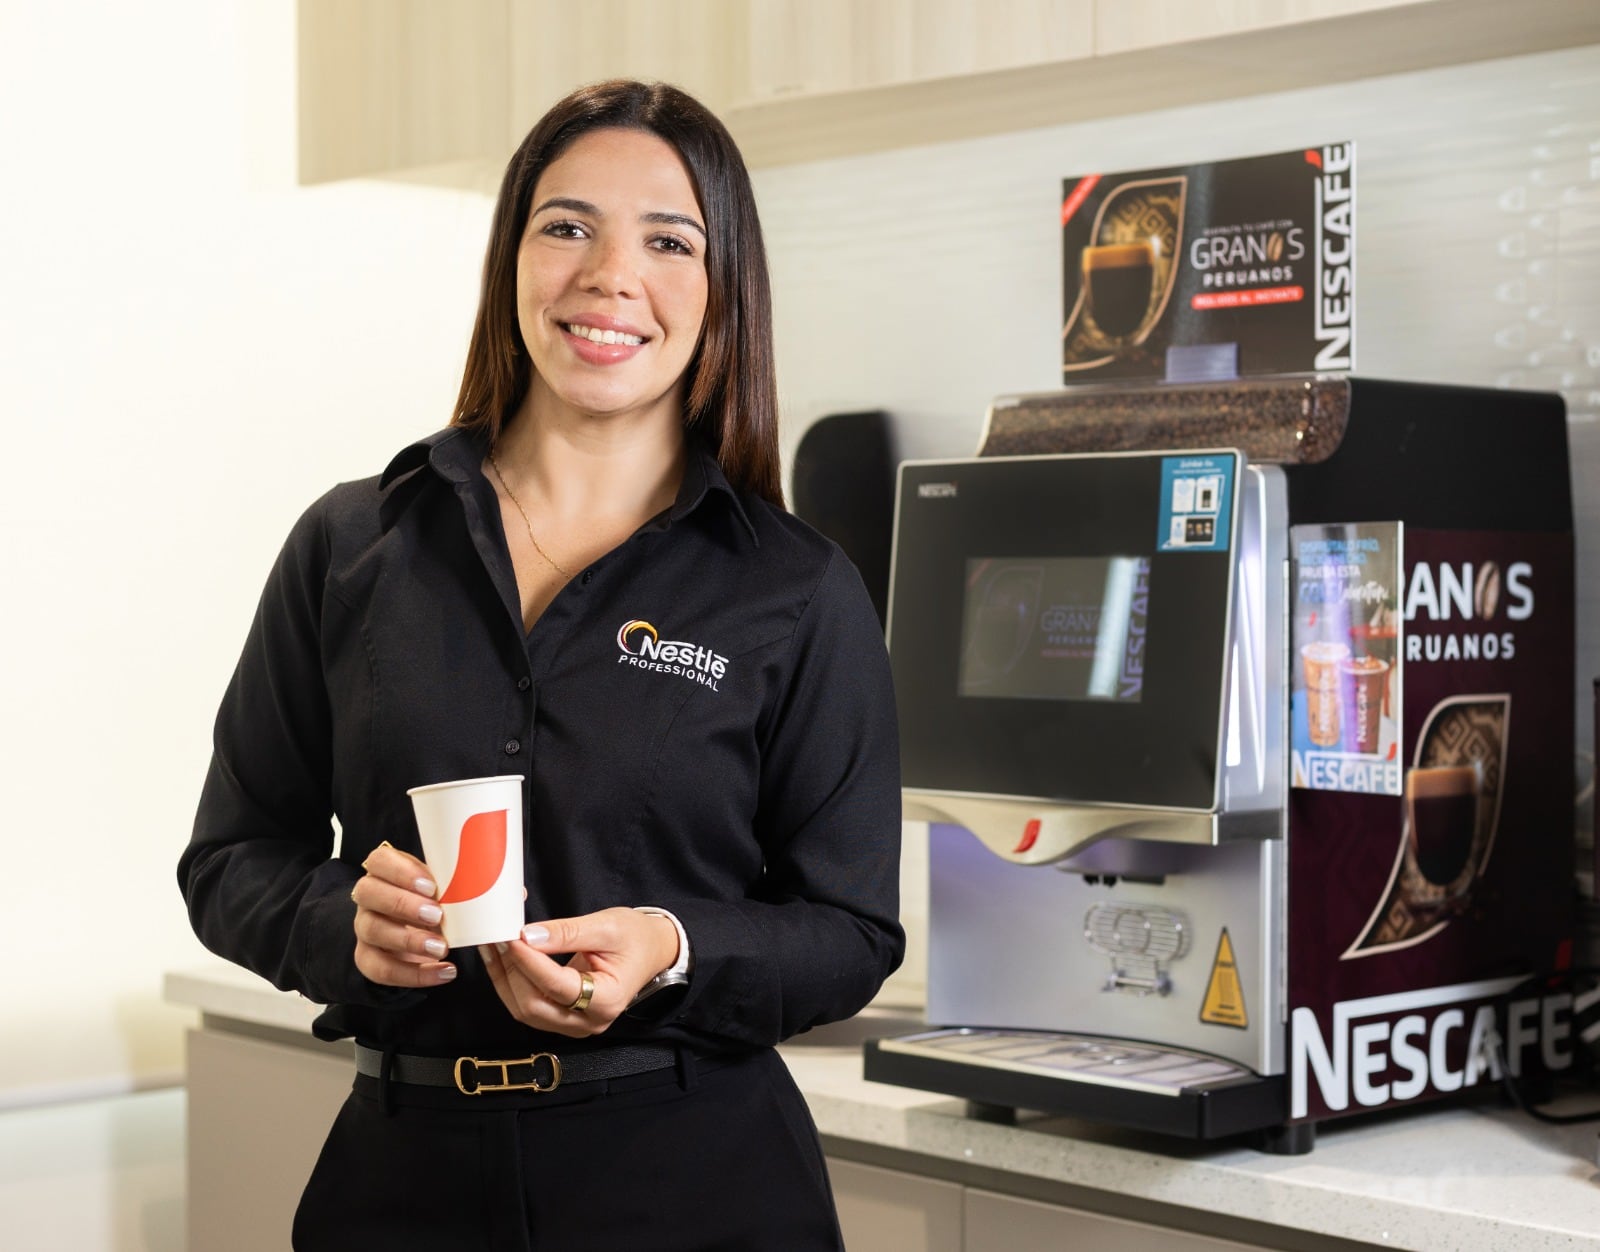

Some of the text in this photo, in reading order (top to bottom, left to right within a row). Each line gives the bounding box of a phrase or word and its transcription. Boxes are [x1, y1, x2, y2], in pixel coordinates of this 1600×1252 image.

[1202, 264, 1294, 288] PERUANOS
[1403, 560, 1535, 621] ANOS
[640, 635, 729, 680] Nestlé
[1406, 632, 1515, 661] RUANOS
[618, 654, 719, 692] PROFESSIONAL
